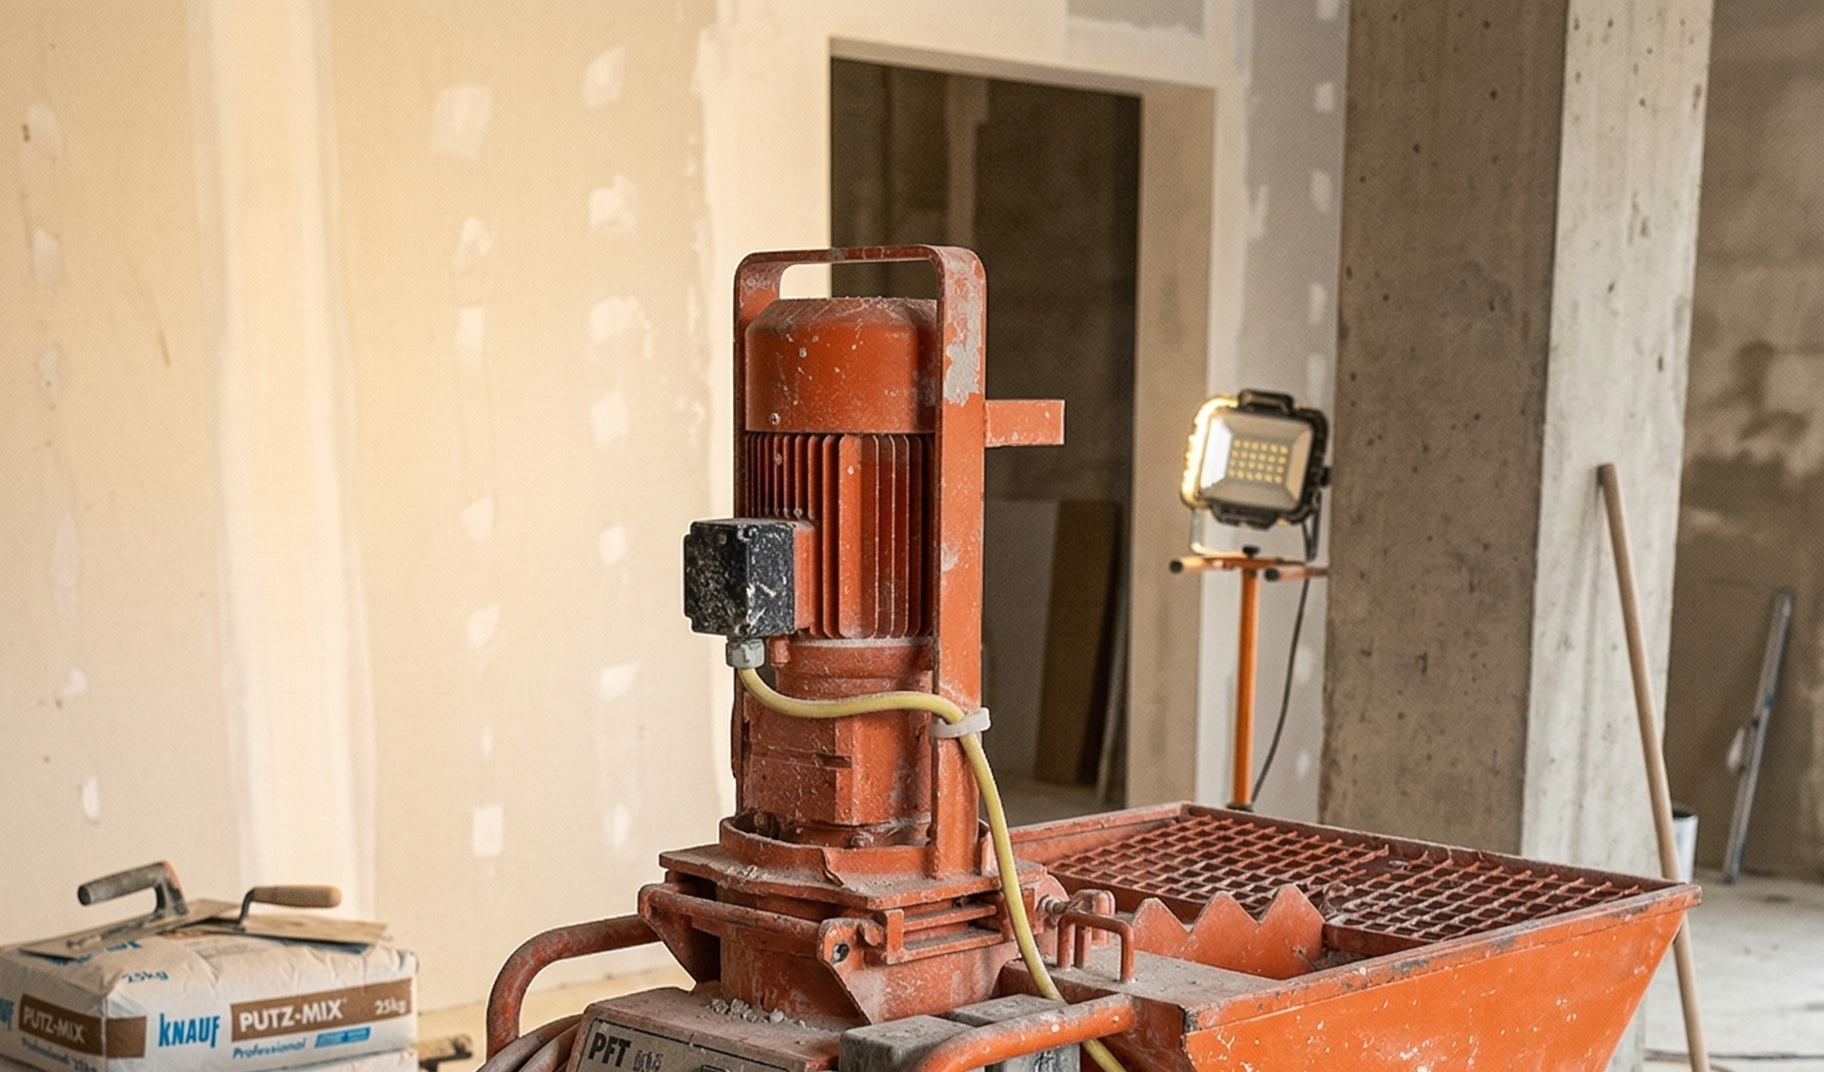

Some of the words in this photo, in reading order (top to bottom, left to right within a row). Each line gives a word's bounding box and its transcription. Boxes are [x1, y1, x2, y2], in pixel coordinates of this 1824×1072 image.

[23, 1006, 85, 1044] PUTZ-MIX
[158, 1012, 220, 1048] KNAUF
[239, 998, 344, 1033] PUTZ-MIX
[232, 1037, 306, 1059] Professional
[588, 1032, 632, 1068] PFT
